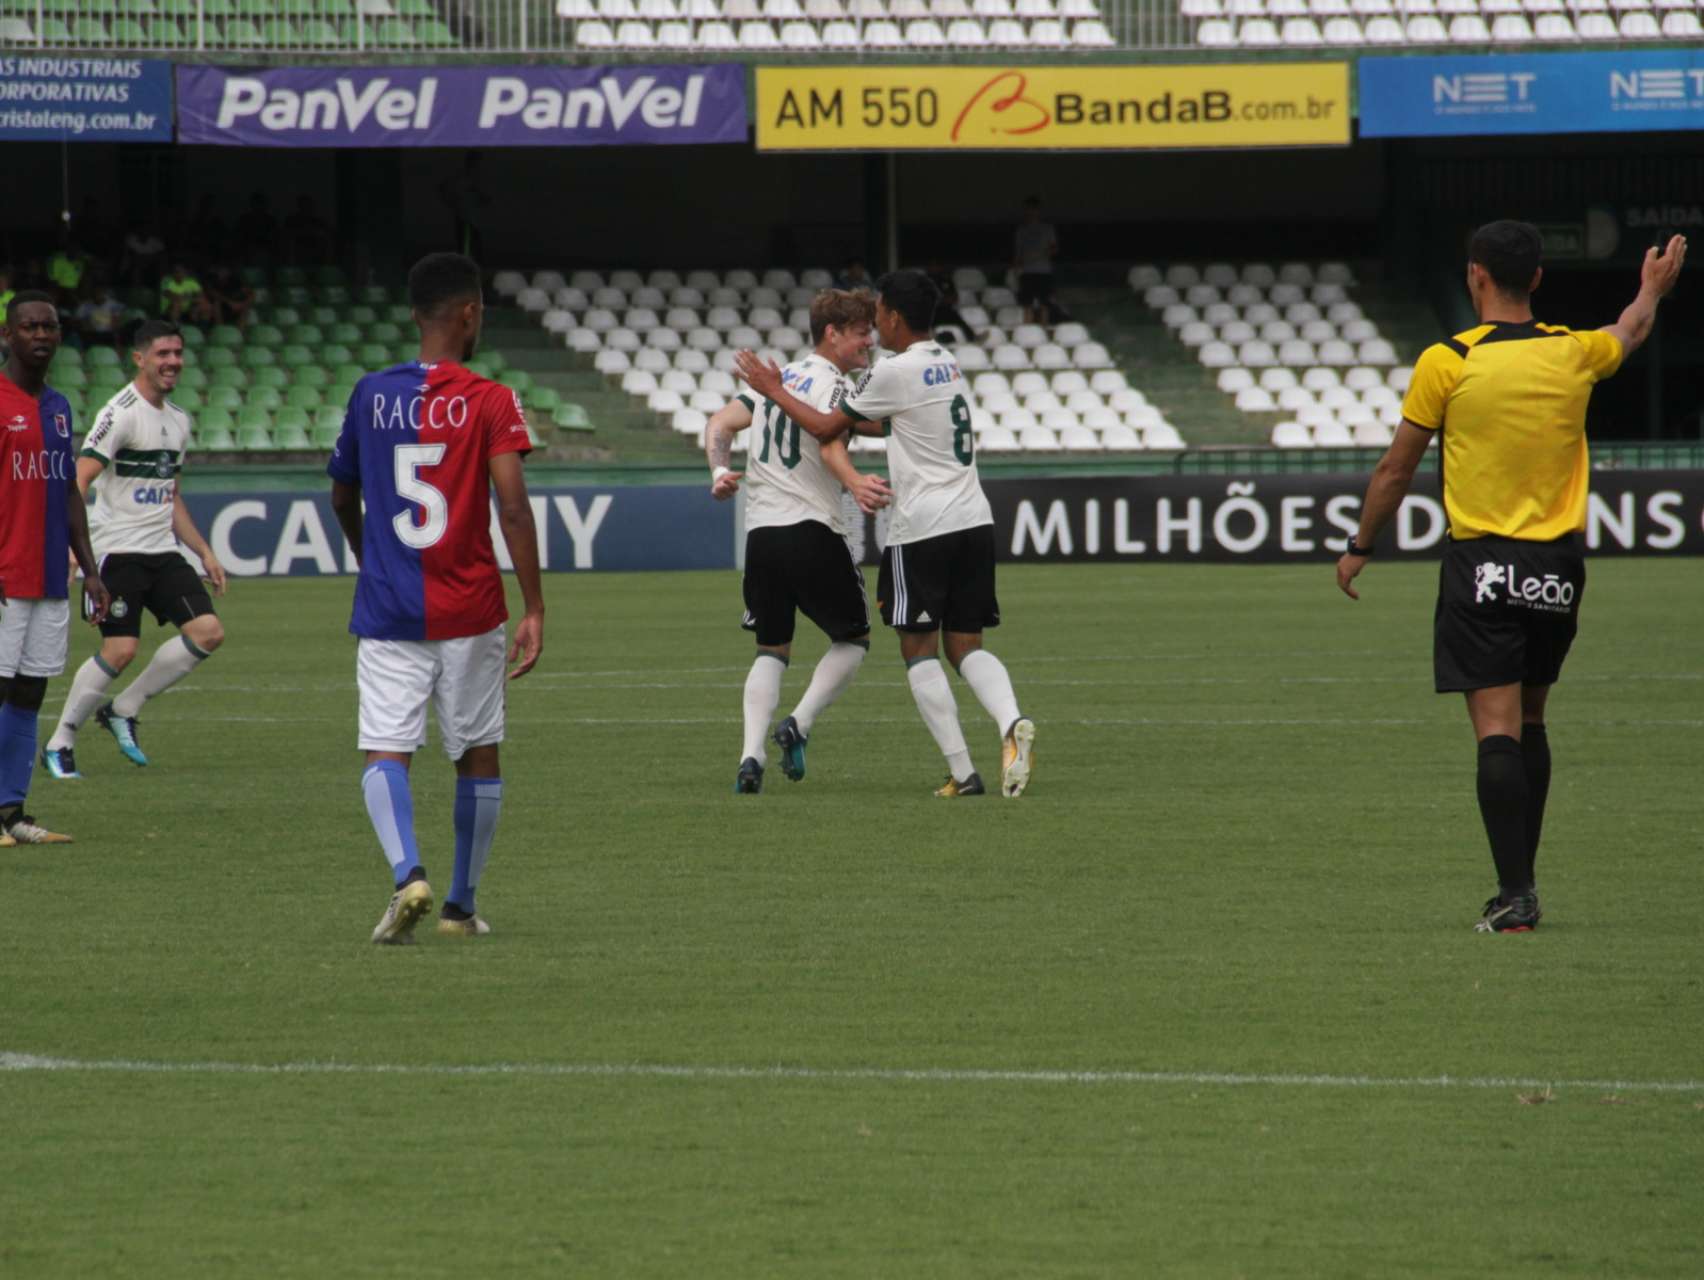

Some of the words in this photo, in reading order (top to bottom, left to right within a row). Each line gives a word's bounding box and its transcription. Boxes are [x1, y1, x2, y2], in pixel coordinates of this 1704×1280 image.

[18, 59, 142, 79] INDUSTRIAIS
[1433, 72, 1536, 102] NET
[217, 77, 438, 133] PanVel
[478, 75, 705, 131] PanVel
[775, 89, 844, 127] AM
[862, 88, 938, 127] 550
[372, 393, 467, 430] RACCO
[950, 393, 973, 467] 8
[392, 443, 448, 549] 5
[1010, 482, 1362, 556] MILHÕES
